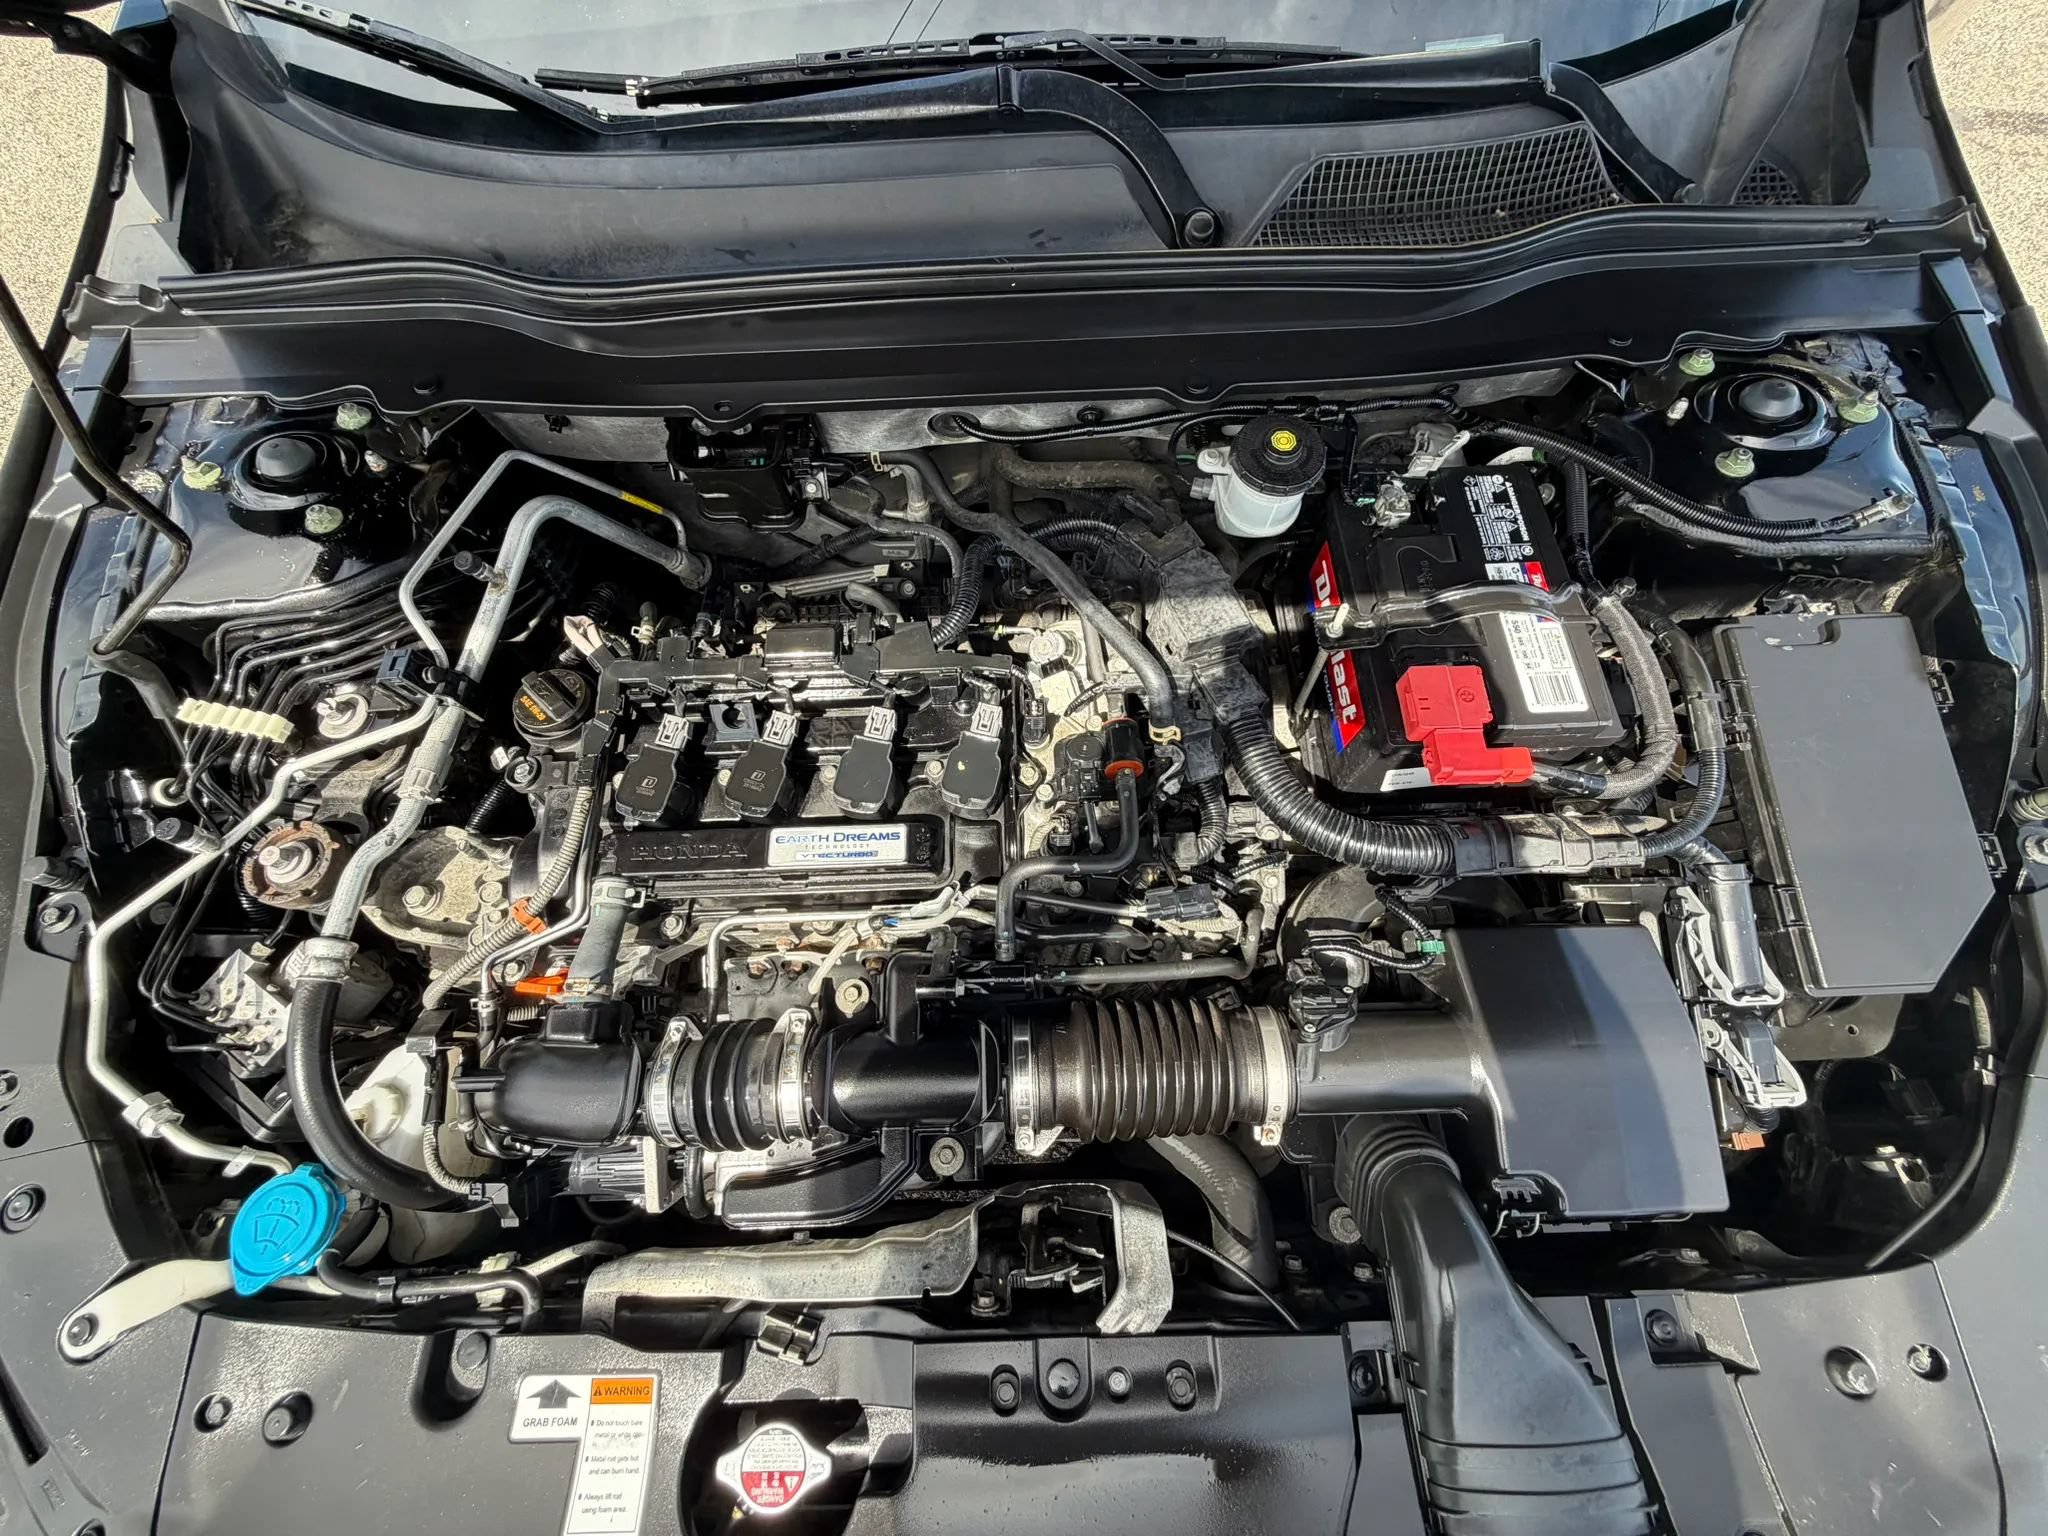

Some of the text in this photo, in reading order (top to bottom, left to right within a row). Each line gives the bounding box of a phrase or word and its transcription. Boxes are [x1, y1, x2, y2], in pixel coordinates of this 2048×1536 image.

[519, 694, 533, 708] SAE
[775, 832, 901, 844] EARTH DREAMS
[630, 842, 748, 861] HONDA
[604, 1386, 650, 1396] WARNING
[522, 1416, 578, 1428] GRAB FOAM
[588, 1467, 600, 1475] and
[583, 1492, 604, 1502] Always
[613, 1491, 623, 1500] rod
[581, 1506, 597, 1516] using
